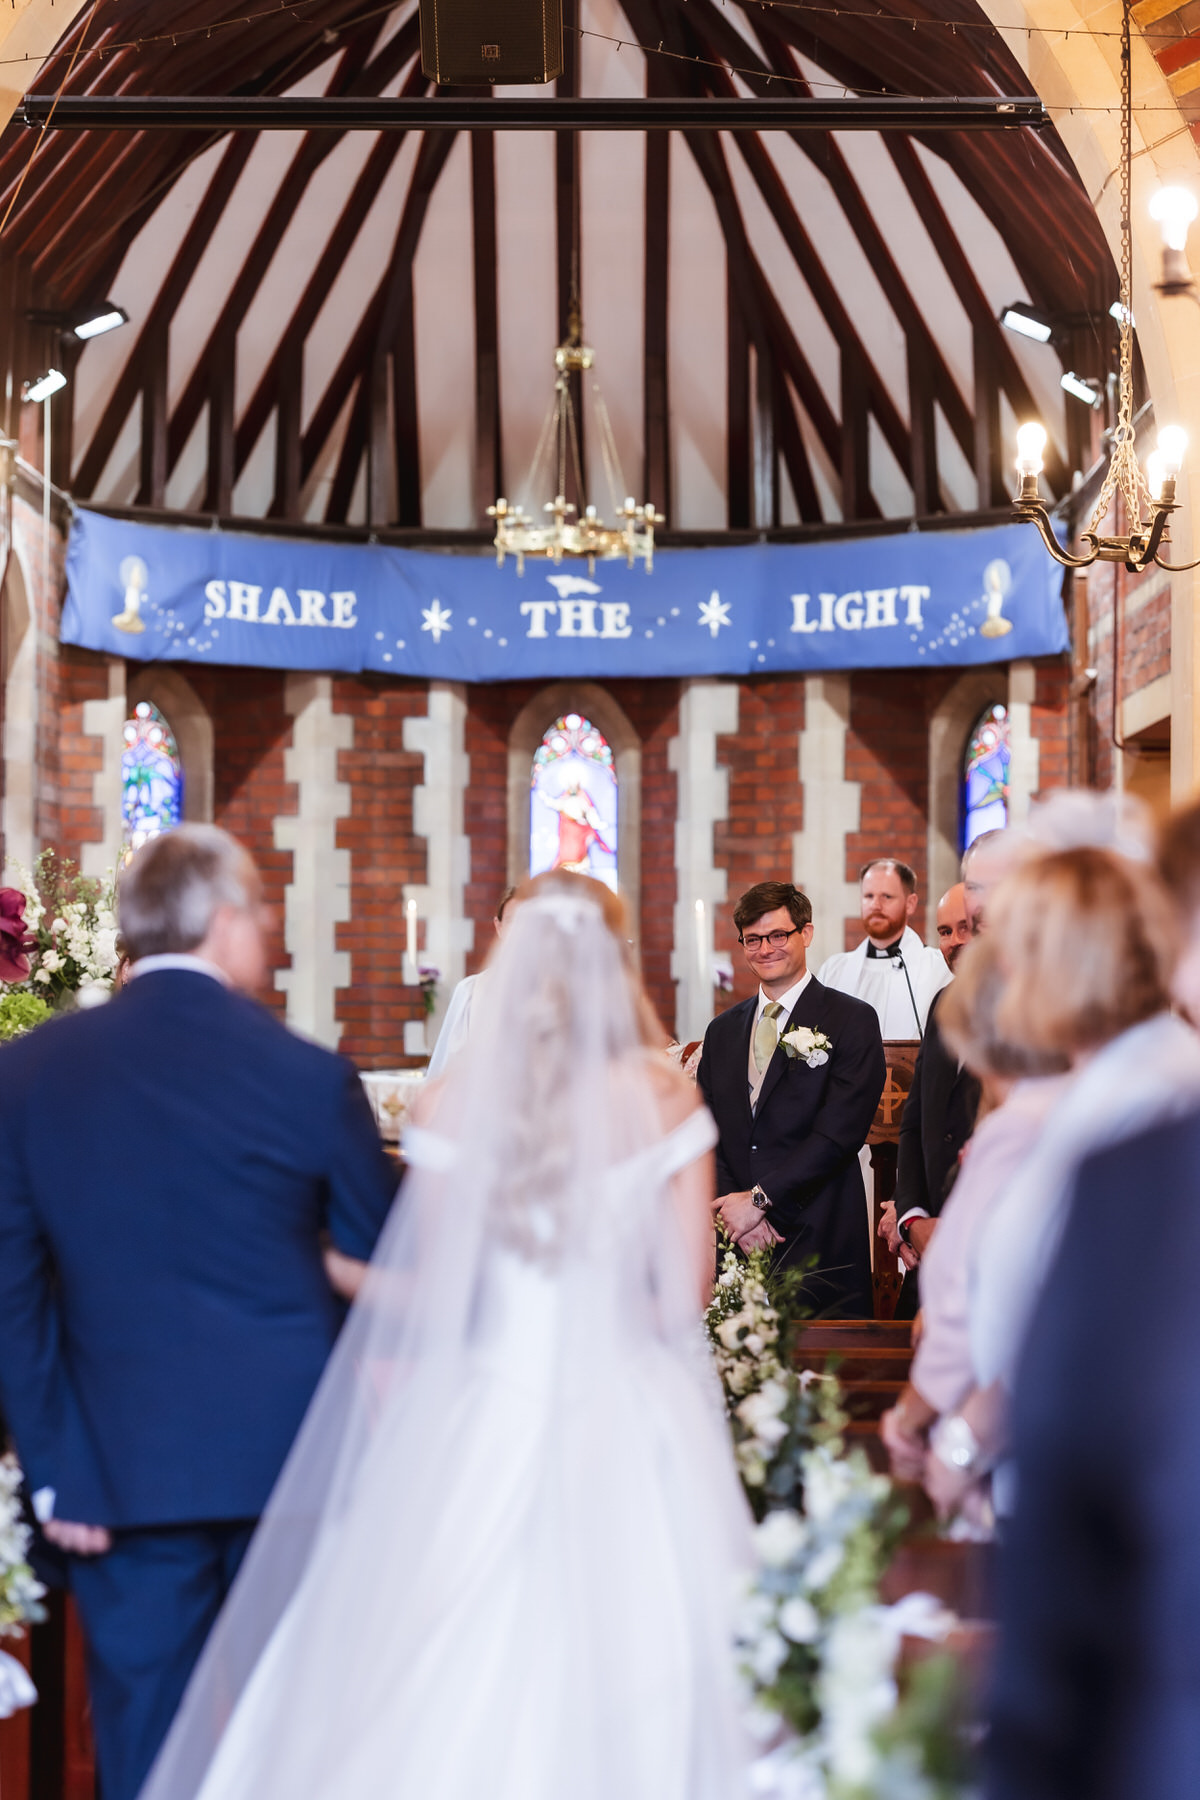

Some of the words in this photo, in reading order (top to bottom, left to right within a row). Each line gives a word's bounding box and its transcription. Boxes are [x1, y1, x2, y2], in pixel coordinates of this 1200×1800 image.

[204, 580, 357, 628] SHARE
[520, 600, 632, 639] THE
[790, 585, 931, 633] LIGHT
